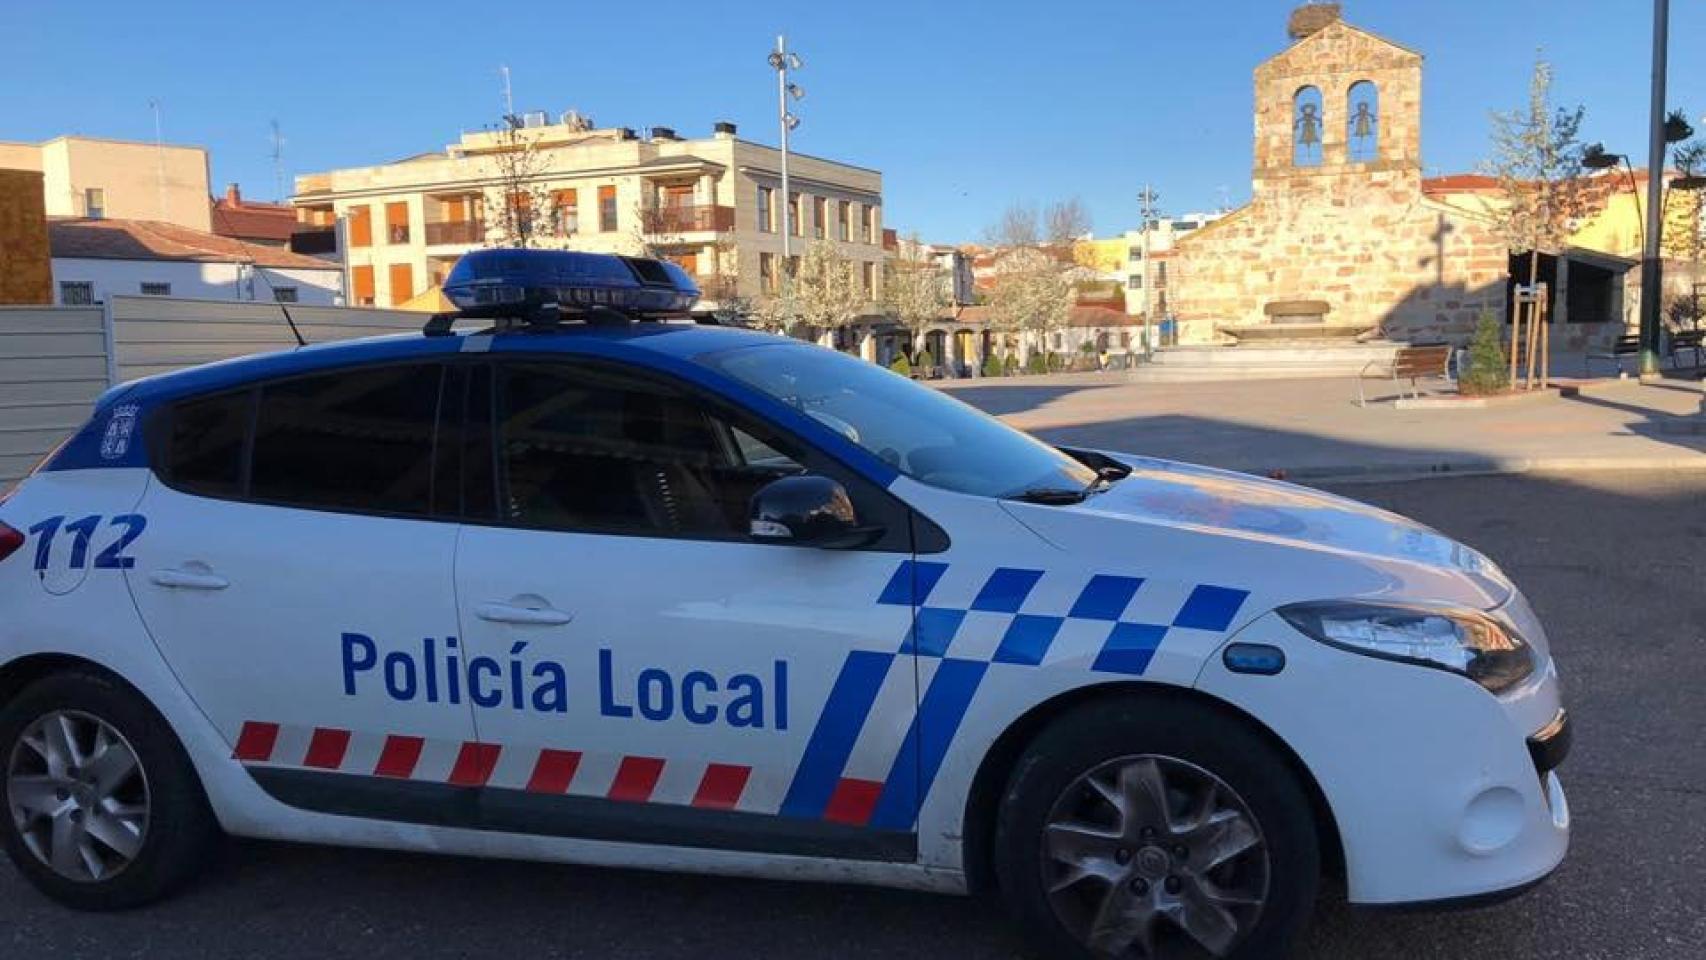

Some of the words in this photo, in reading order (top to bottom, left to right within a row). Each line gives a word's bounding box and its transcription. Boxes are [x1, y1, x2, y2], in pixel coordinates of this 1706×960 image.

[29, 513, 147, 570] 112
[340, 632, 569, 714] Policía
[599, 648, 788, 730] Local
